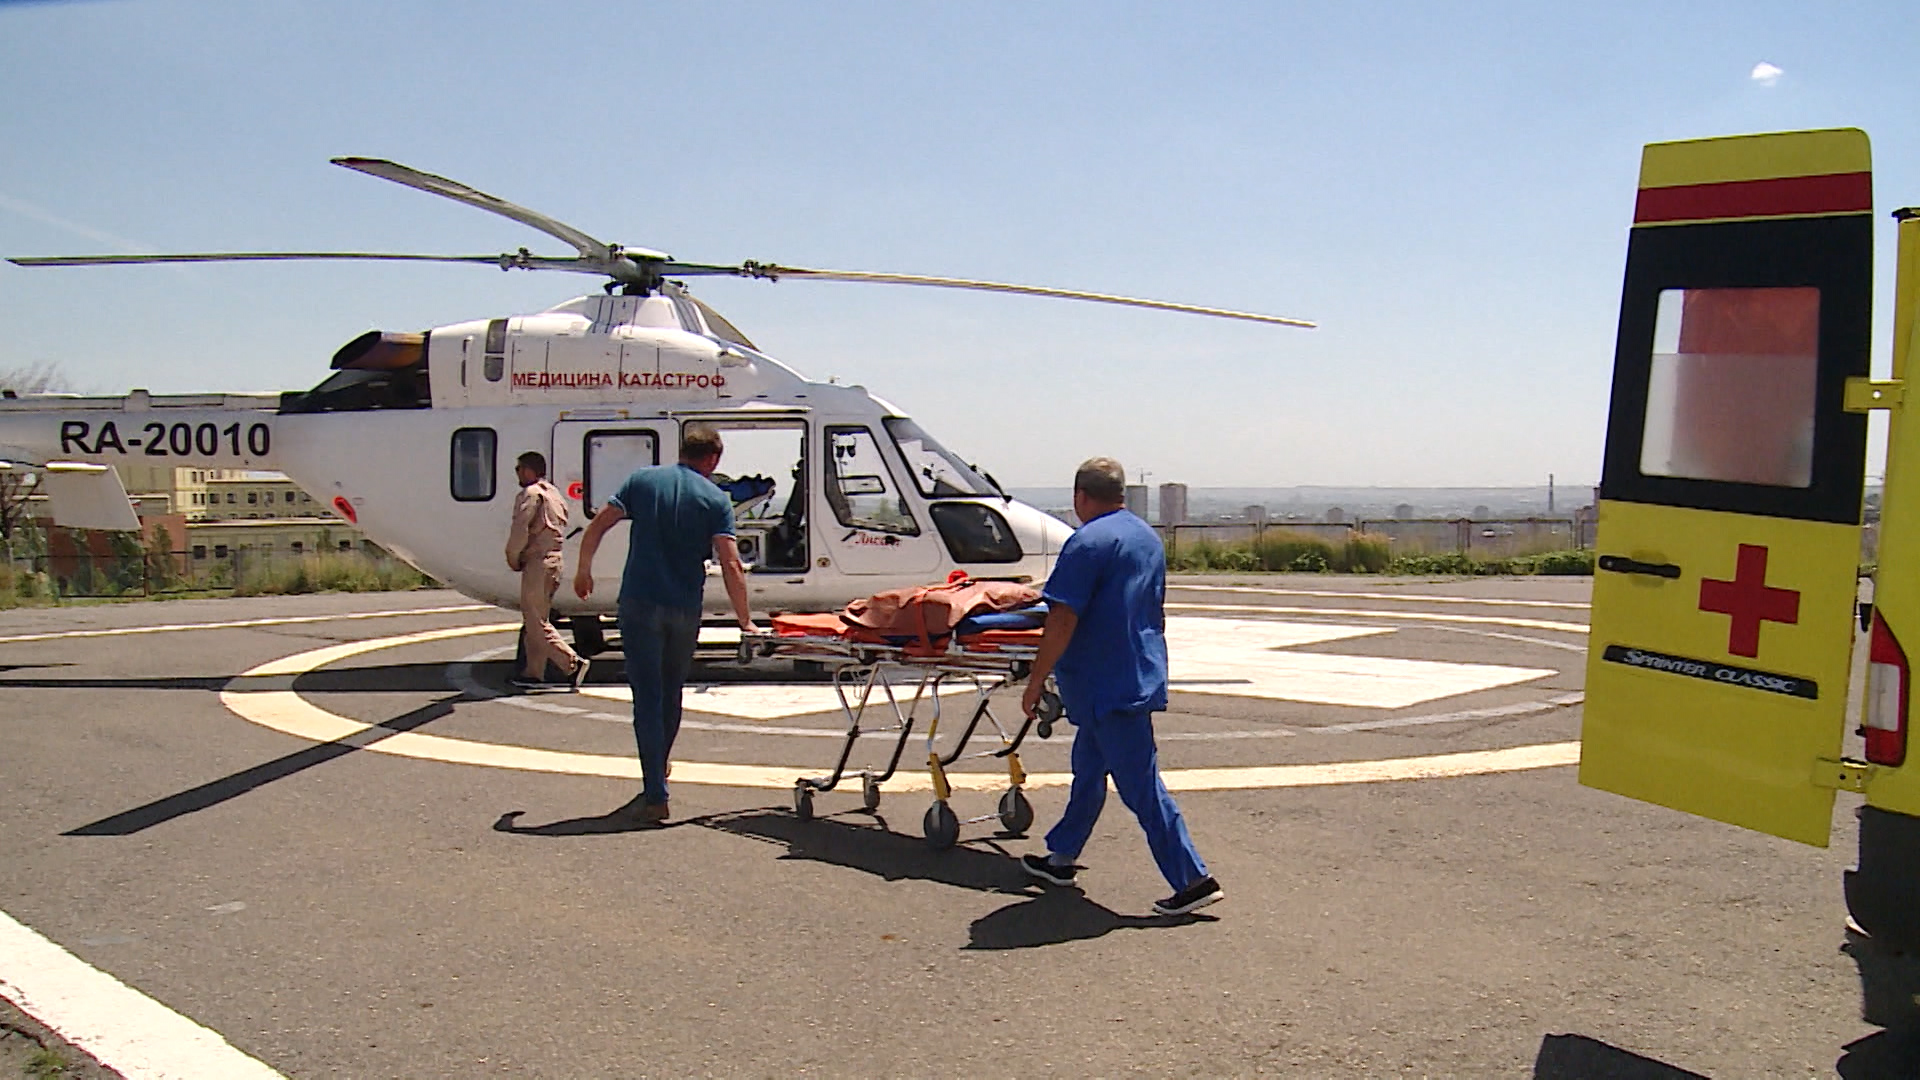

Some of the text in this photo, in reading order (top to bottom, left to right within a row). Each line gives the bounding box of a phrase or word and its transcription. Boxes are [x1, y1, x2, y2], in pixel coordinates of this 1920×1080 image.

[513, 372, 725, 388] МЕДИЦИНА КАТАСТРОФ
[61, 421, 270, 456] RA-20010
[1715, 668, 1797, 693] CLASSIC
